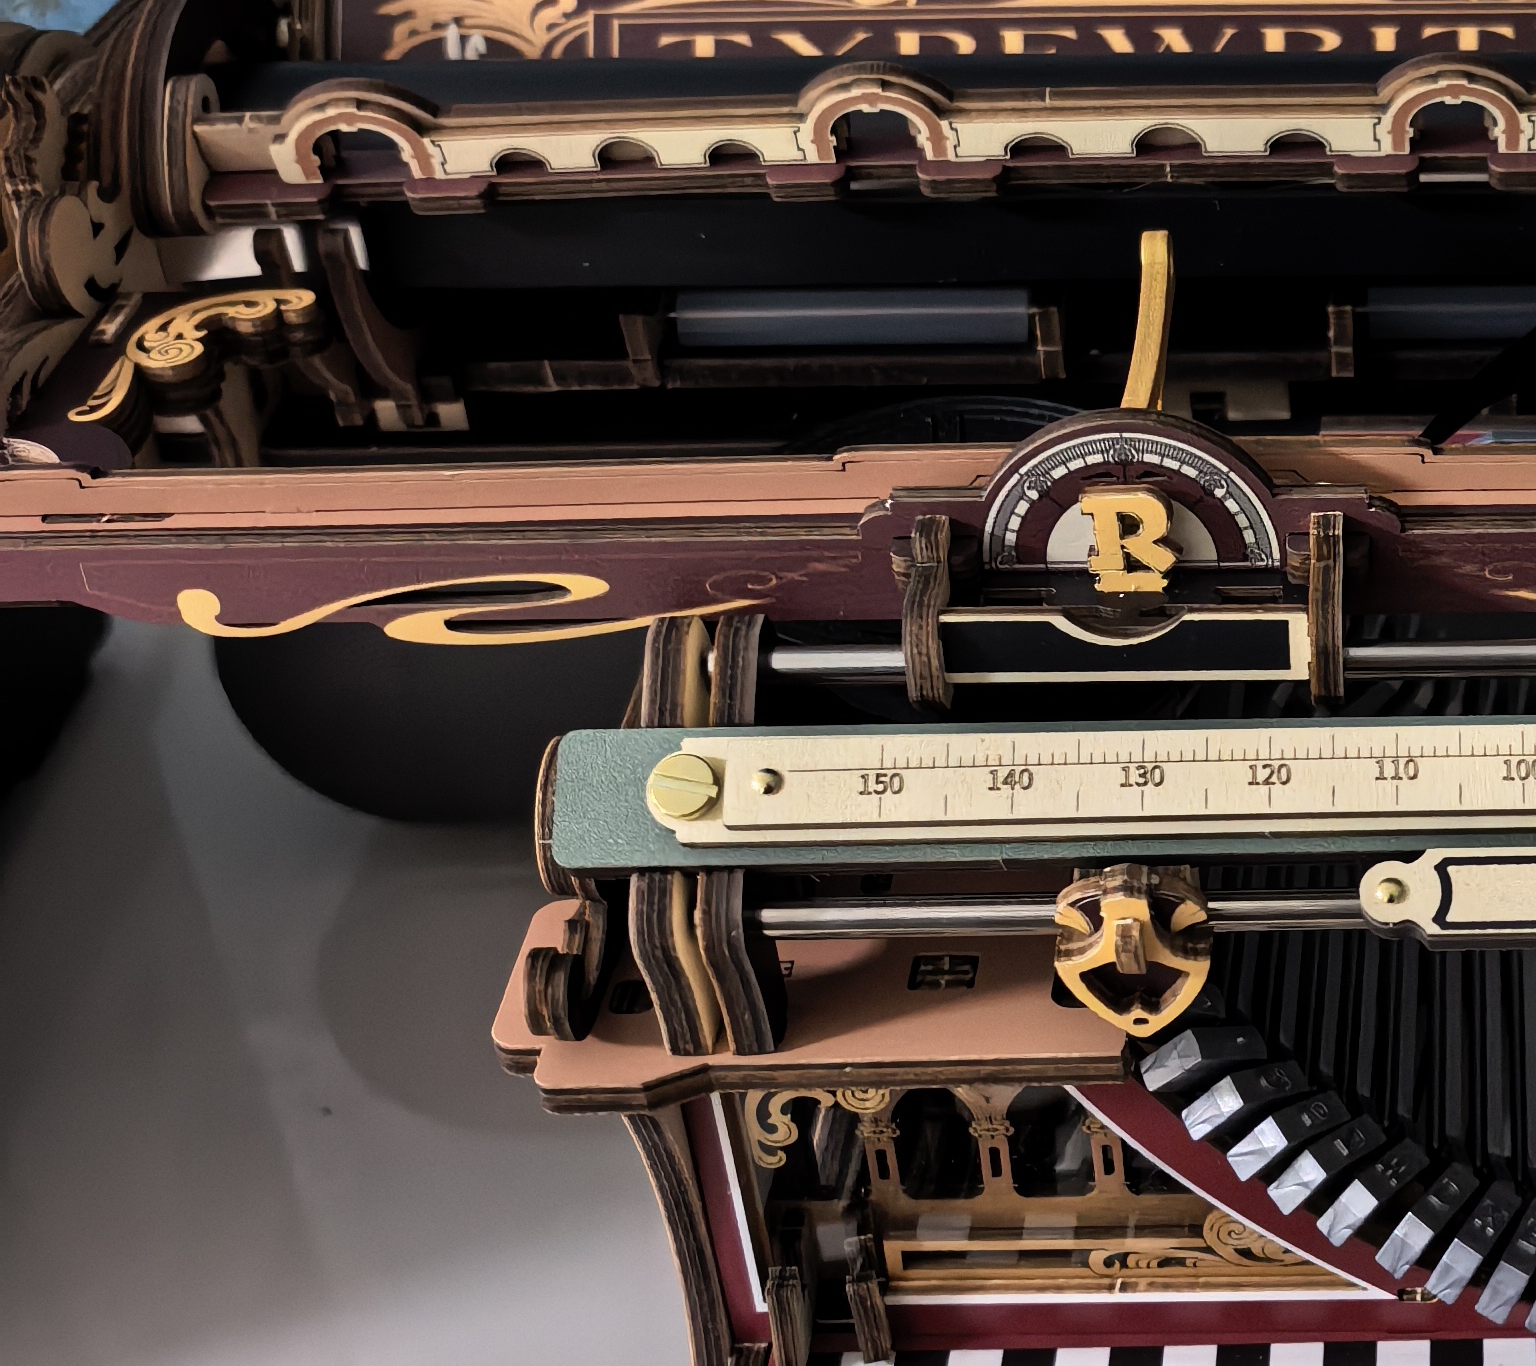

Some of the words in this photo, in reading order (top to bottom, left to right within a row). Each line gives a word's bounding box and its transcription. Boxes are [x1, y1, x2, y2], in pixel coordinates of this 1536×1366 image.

[858, 771, 905, 796] 150
[987, 767, 1034, 792] 140
[1119, 764, 1166, 788] 130
[1247, 763, 1292, 786] 120
[1374, 758, 1419, 782] 110
